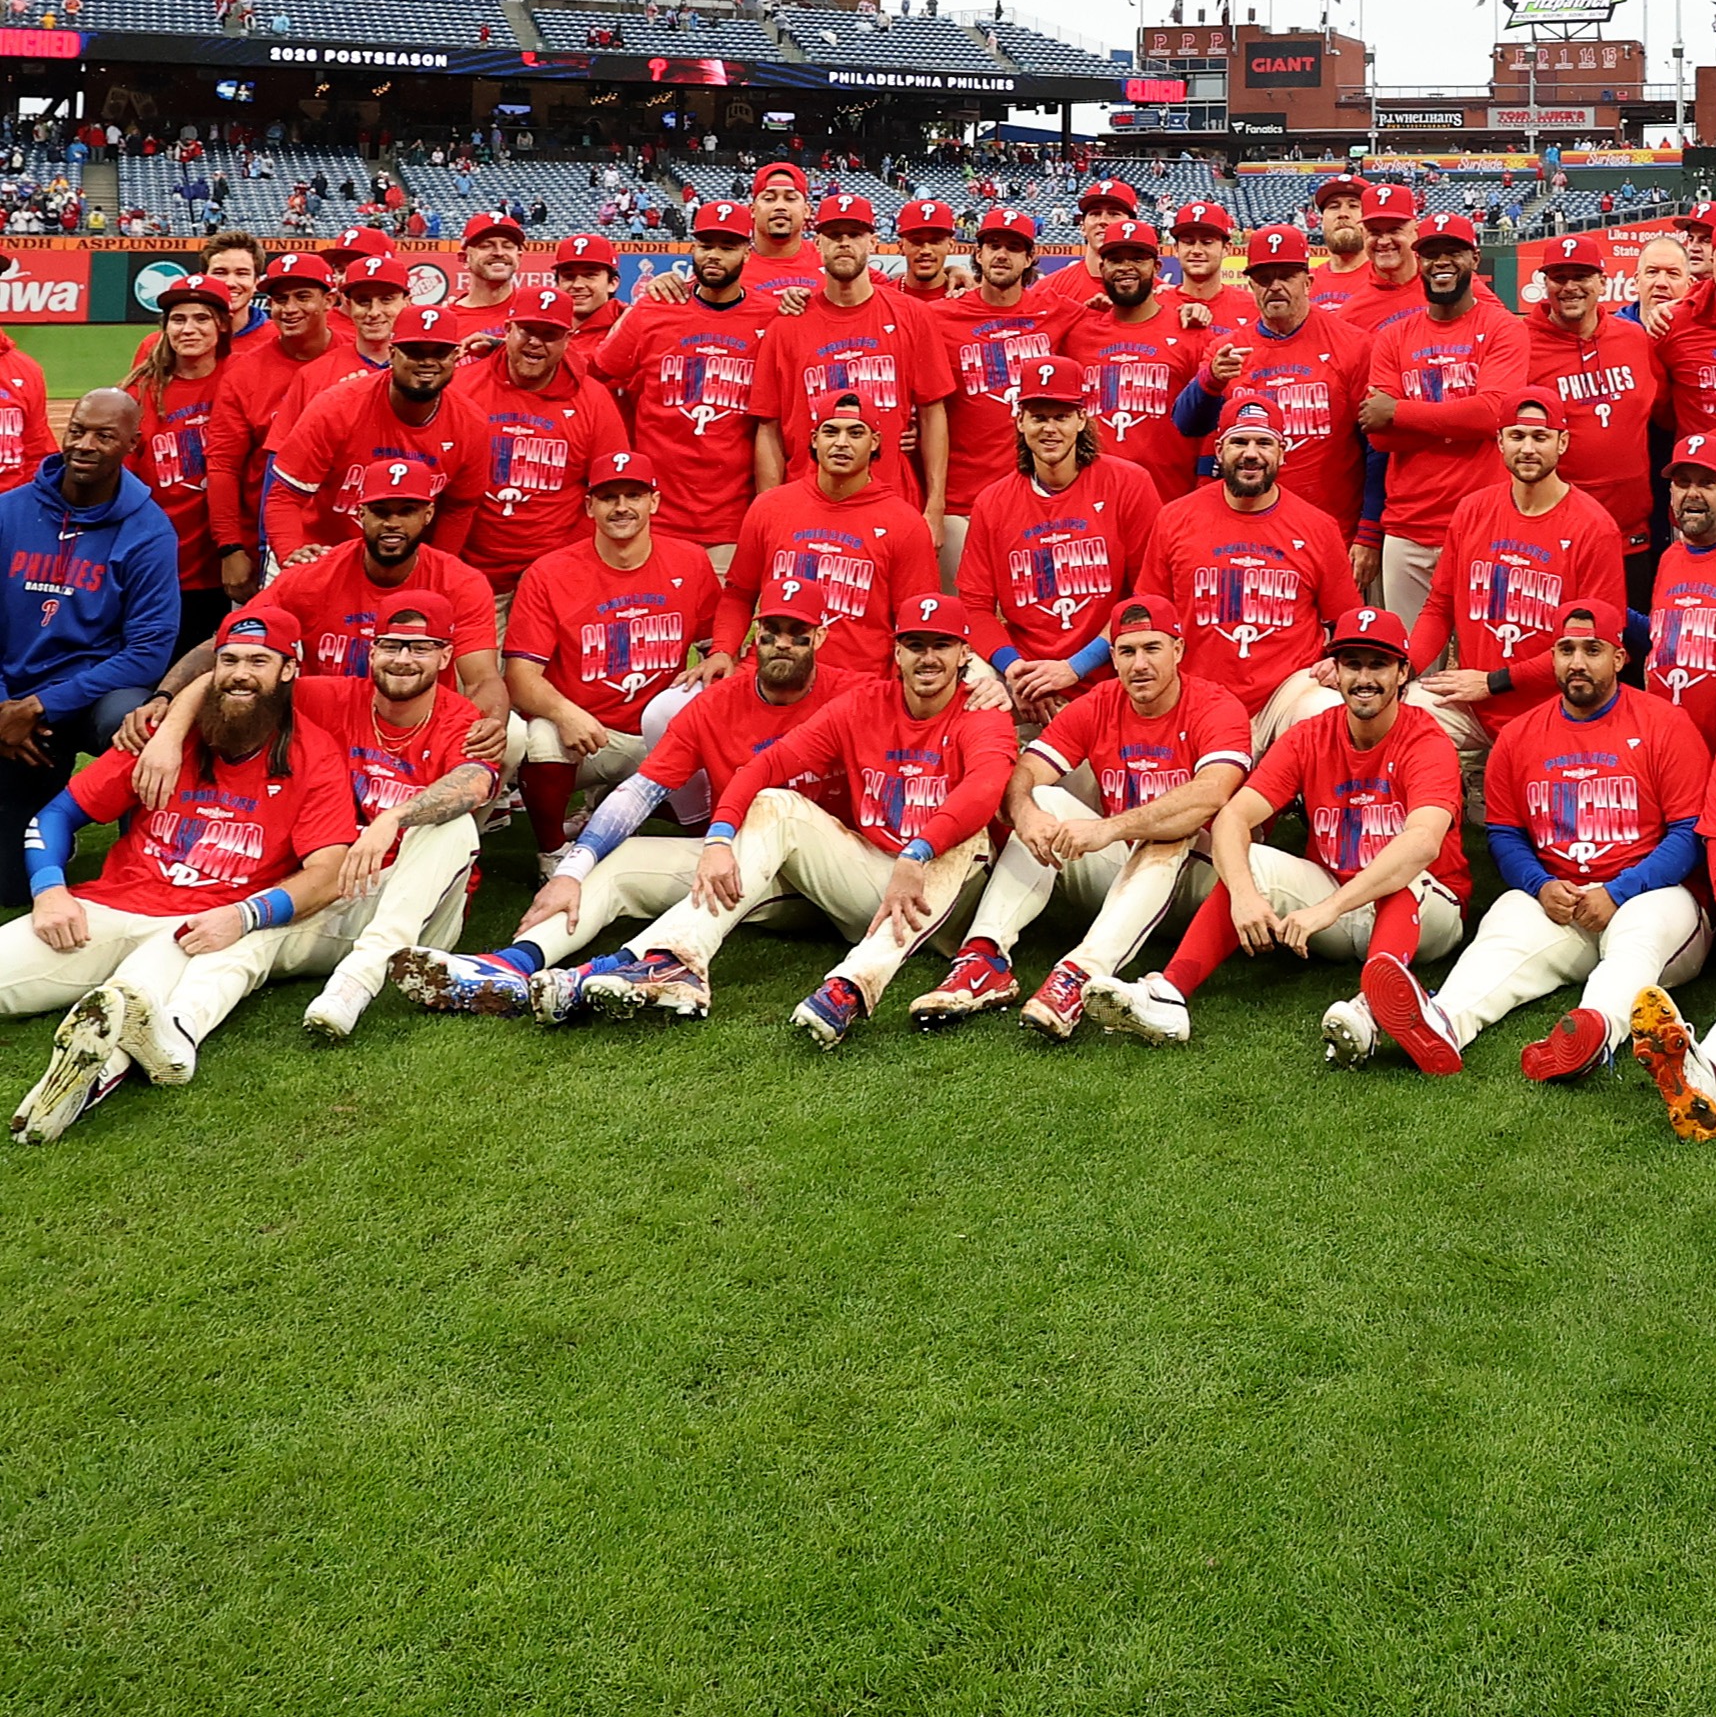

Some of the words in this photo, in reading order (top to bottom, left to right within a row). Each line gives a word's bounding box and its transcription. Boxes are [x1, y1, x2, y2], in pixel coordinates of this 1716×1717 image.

[270, 47, 318, 63] 2026
[323, 49, 448, 69] POSTSEASON
[1251, 57, 1316, 73] GIANT
[829, 71, 942, 90] PHILADELPHIA
[947, 76, 1014, 92] PHILLIES
[1245, 124, 1284, 136] Fanatics
[1372, 159, 1417, 172] Surfside
[1457, 158, 1504, 171] Surfside
[1586, 153, 1631, 167] Surfside
[1608, 230, 1630, 241] Like
[1630, 232, 1638, 241] a
[76, 238, 189, 251] ASPLUNDH
[1613, 245, 1640, 257] State
[1556, 365, 1635, 401] PHILLIES
[1594, 403, 1611, 428] P
[41, 598, 60, 628] P
